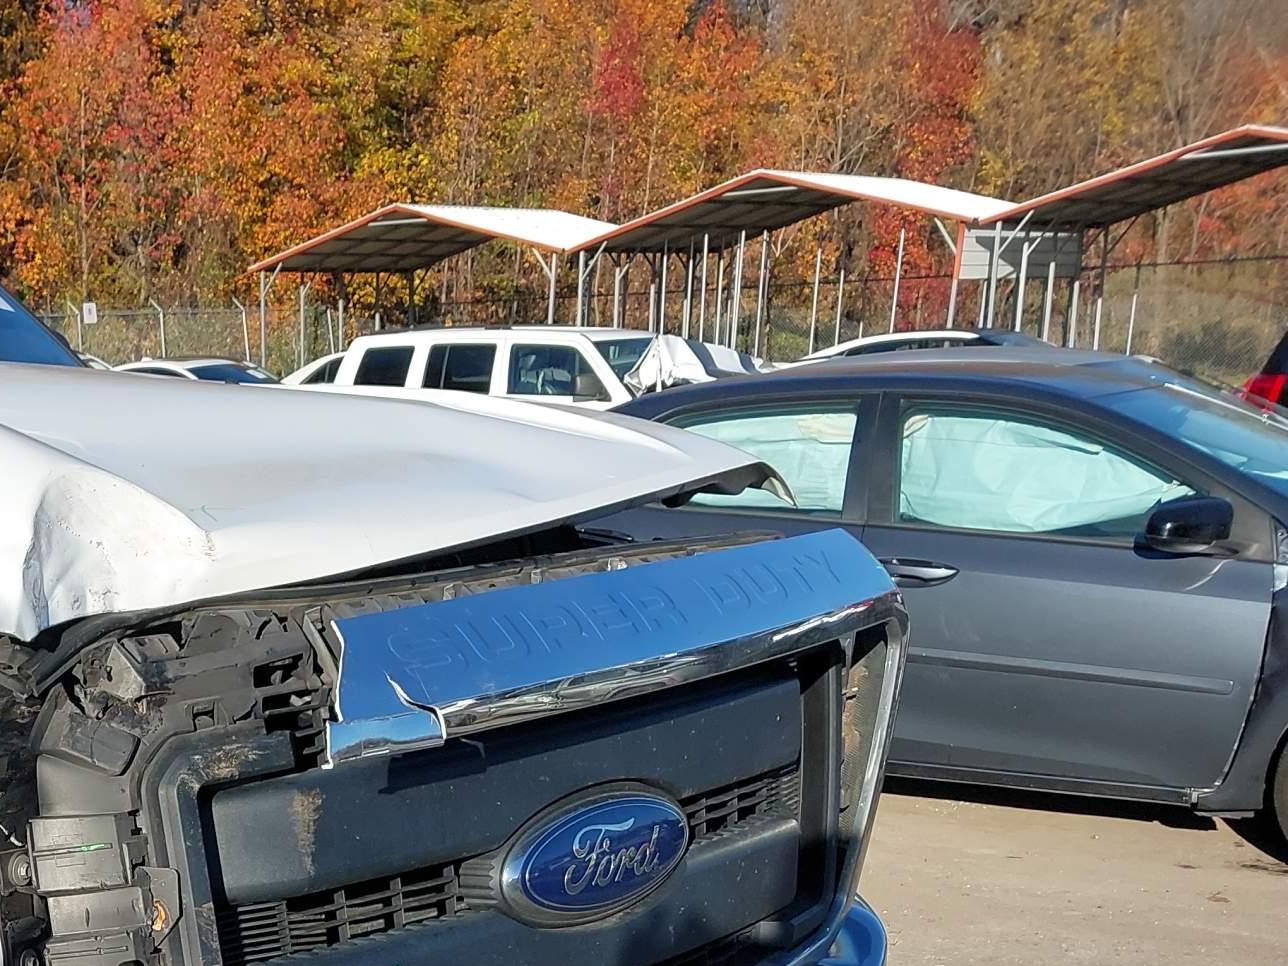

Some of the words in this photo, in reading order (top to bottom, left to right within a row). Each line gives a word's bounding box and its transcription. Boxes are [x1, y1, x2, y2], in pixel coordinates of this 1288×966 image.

[387, 585, 688, 671] SUPER
[688, 550, 841, 616] DUTY
[564, 817, 660, 896] Ford
